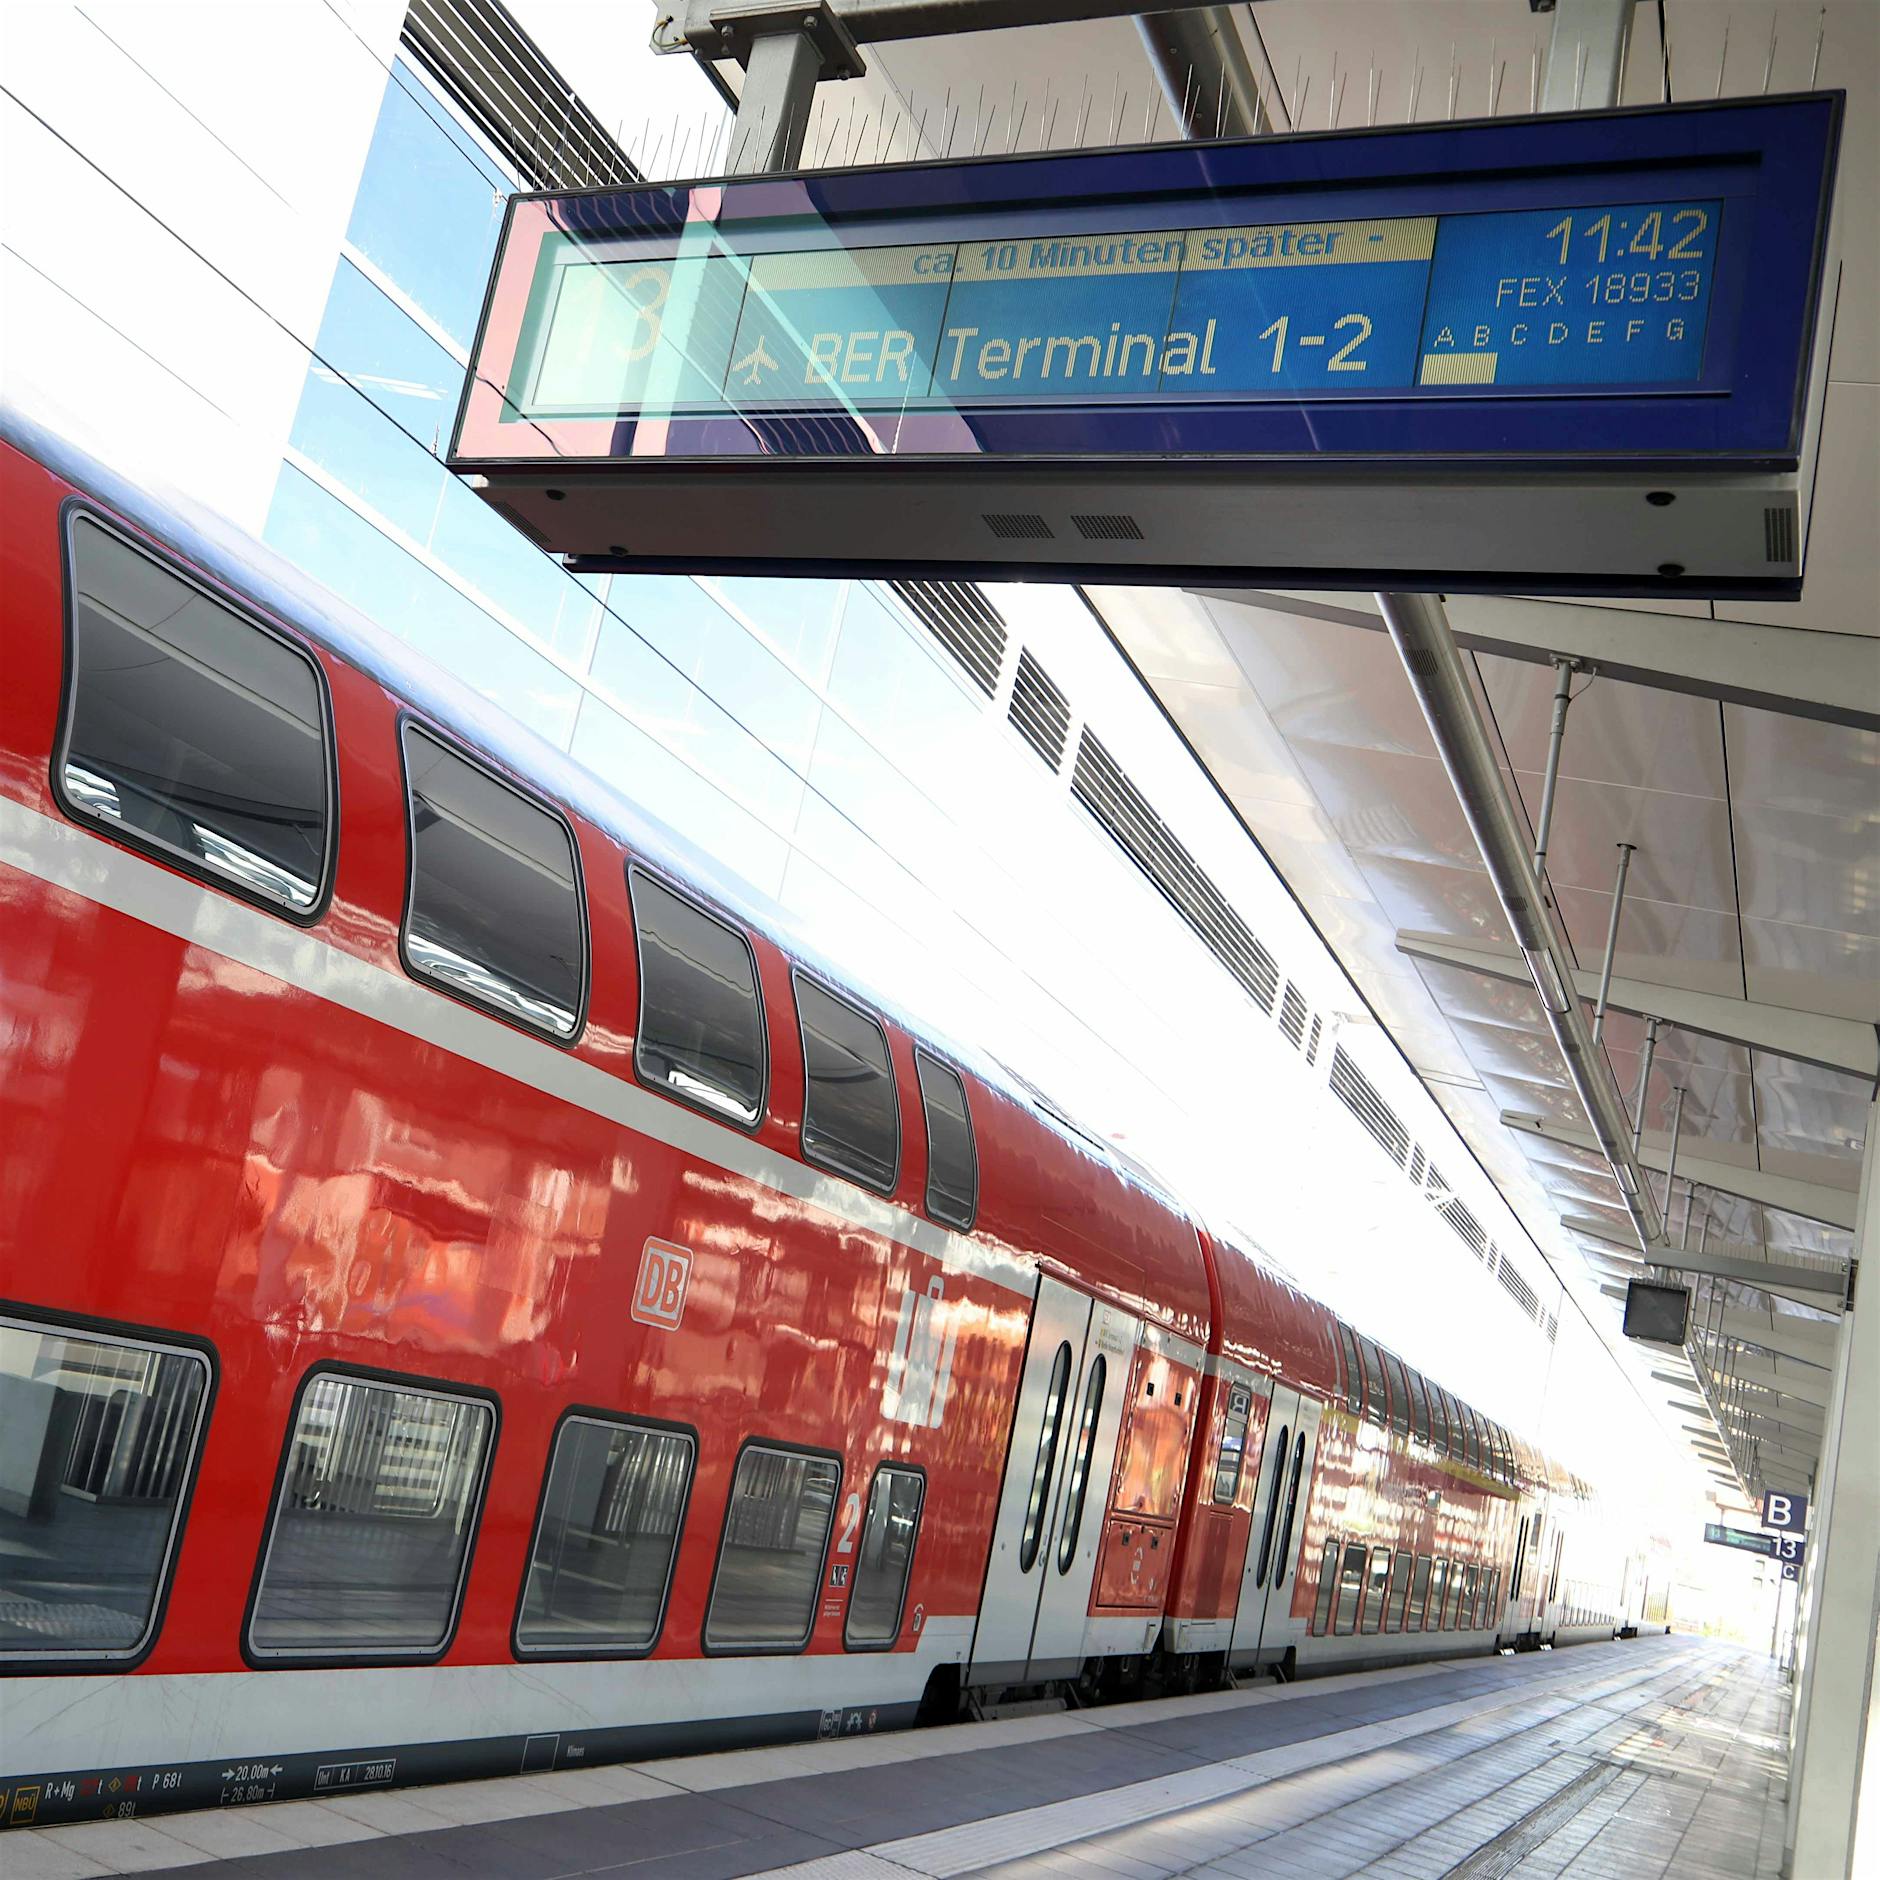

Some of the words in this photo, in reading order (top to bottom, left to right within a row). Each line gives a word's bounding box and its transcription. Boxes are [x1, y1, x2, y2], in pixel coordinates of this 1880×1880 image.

[913, 252, 963, 275] ca.
[983, 244, 1018, 271] 10
[1028, 237, 1186, 269] Minuten
[1201, 229, 1344, 267] später
[1546, 208, 1708, 265] 11:42
[1496, 275, 1568, 308] FEX
[1585, 270, 1700, 304] 18933
[804, 329, 916, 384] BER
[947, 318, 1217, 380] Terminal
[1259, 313, 1373, 373] 1-2
[1434, 326, 1455, 348] A
[1473, 324, 1491, 347] B
[1511, 323, 1528, 345] C
[1548, 322, 1569, 345] D
[1587, 320, 1605, 343] E
[1626, 319, 1645, 342] F
[1666, 318, 1685, 341] G
[836, 1493, 860, 1553] 2
[1767, 1494, 1792, 1526] B
[1772, 1537, 1797, 1559] 13
[1783, 1565, 1795, 1579] C
[152, 1773, 160, 1790] P
[163, 1772, 182, 1789] 68t
[14, 1794, 36, 1812] NBÜ
